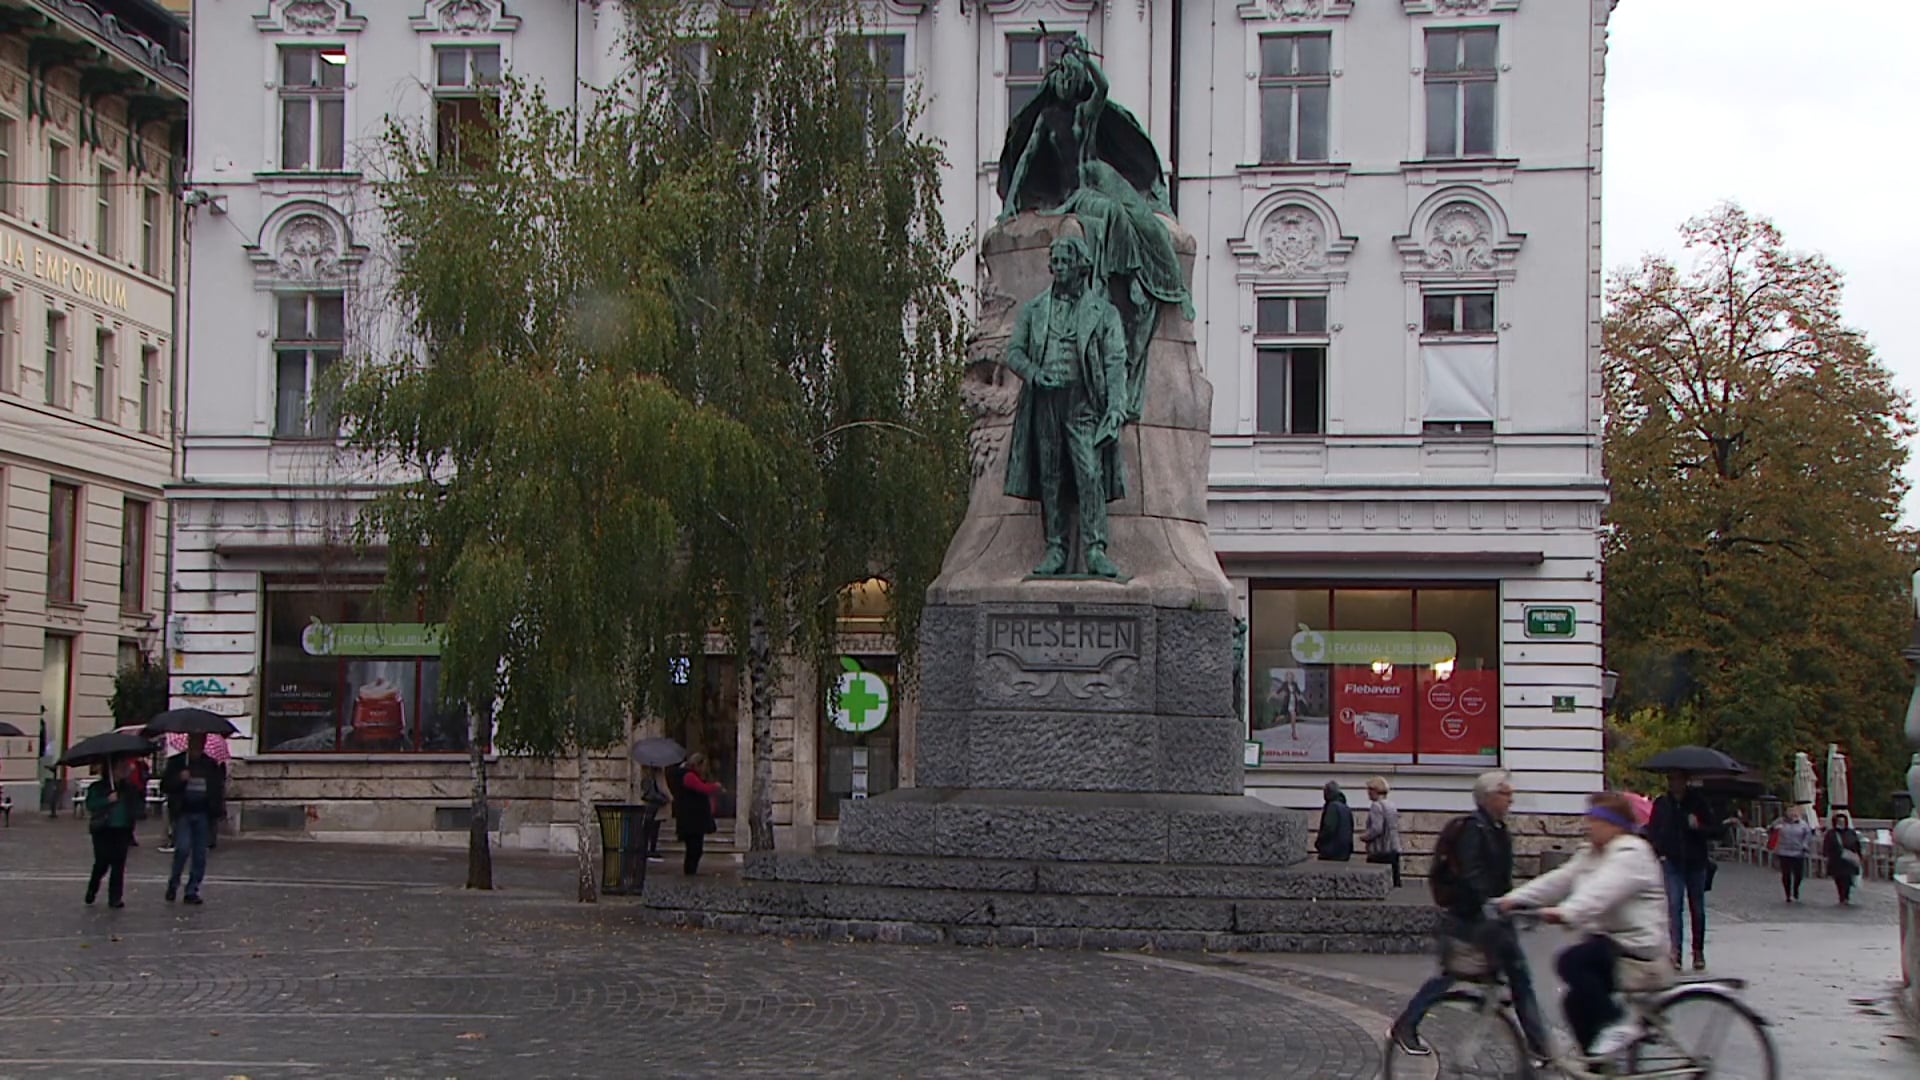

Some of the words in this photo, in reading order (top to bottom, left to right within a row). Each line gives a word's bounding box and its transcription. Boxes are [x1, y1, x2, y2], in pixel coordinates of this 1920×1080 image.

[34, 246, 128, 310] EMPORIUM
[1329, 642, 1380, 655] LEKARNA
[1385, 642, 1451, 655] LJUBLJANA
[1344, 684, 1401, 694] Flebaven
